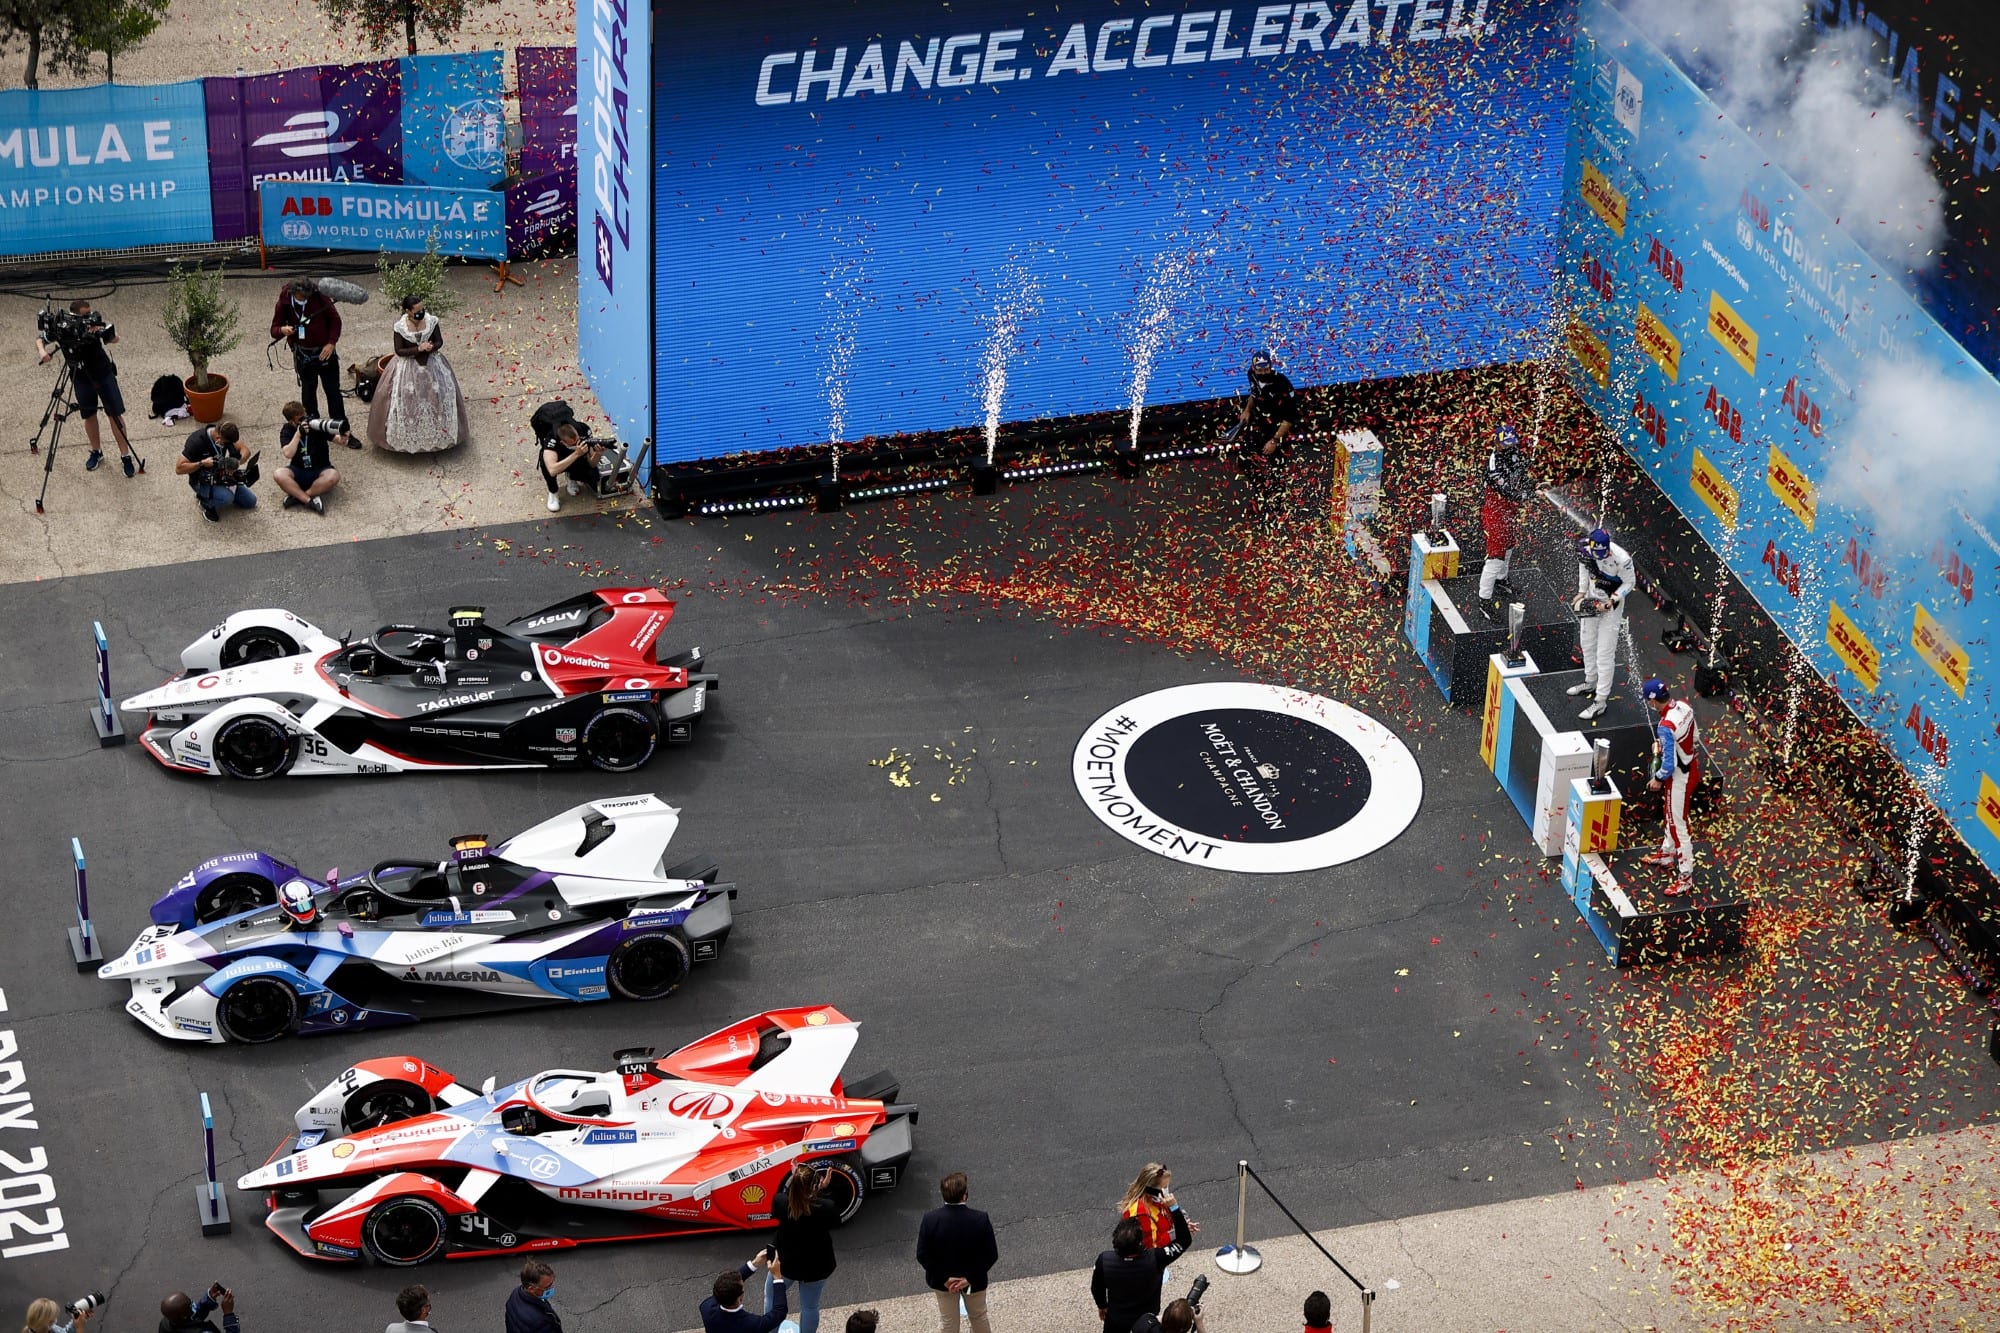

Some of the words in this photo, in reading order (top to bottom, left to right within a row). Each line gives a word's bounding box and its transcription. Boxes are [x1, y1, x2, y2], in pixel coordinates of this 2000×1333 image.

[755, 29, 1031, 107] CHANGE.
[144, 120, 174, 161] E
[353, 163, 365, 180] E
[281, 197, 333, 216] ABB
[342, 196, 464, 221] FORMULA
[474, 201, 488, 222] E
[1585, 177, 1618, 212] DHL
[317, 225, 369, 238] WORLD
[375, 227, 490, 242] CHAMPIONSHIP
[1647, 237, 1683, 294] ABB
[1755, 241, 1787, 282] WORLD
[1773, 216, 1847, 313] FORMULA
[1714, 311, 1750, 356] DHL
[1632, 390, 1668, 449] ABB
[1703, 384, 1743, 443] ABB
[1782, 378, 1821, 439] ABB
[1696, 468, 1731, 515] DHL
[1772, 464, 1809, 512] DHL
[1761, 539, 1800, 598] ABB
[1841, 538, 1884, 600] ABB
[456, 618, 475, 627] LOT
[527, 608, 582, 630] Ansys
[563, 655, 610, 670] vodafone
[1833, 623, 1871, 675] DHL
[1919, 626, 1961, 677] DHL
[424, 675, 442, 684] BOS
[616, 693, 647, 701] MICHELIN
[410, 726, 500, 739] PORSCHE
[1200, 723, 1237, 757] MOËT
[1905, 703, 1948, 768] ABB
[304, 738, 328, 757] 36
[357, 764, 387, 774] Mobil
[1225, 758, 1242, 768] &
[1086, 715, 1223, 860] #MOETMOMENT
[1199, 751, 1243, 807] CHAMPAGNE
[1233, 769, 1286, 830] CHANDON
[460, 849, 483, 858] DEN
[429, 914, 452, 923] Julius
[637, 917, 669, 926] MICHELIN
[405, 944, 440, 964] Julius
[442, 935, 464, 949] Bär
[225, 963, 262, 979] Julius
[264, 960, 290, 971] Bär
[424, 971, 502, 983] MAGNA
[564, 966, 604, 976] Einhell
[625, 1064, 647, 1074] LYN
[592, 1130, 617, 1142] Julius
[619, 1130, 635, 1140] Bär
[817, 1142, 852, 1150] MICHELIN
[0, 1147, 70, 1259] 2021
[460, 1214, 489, 1236] 94
